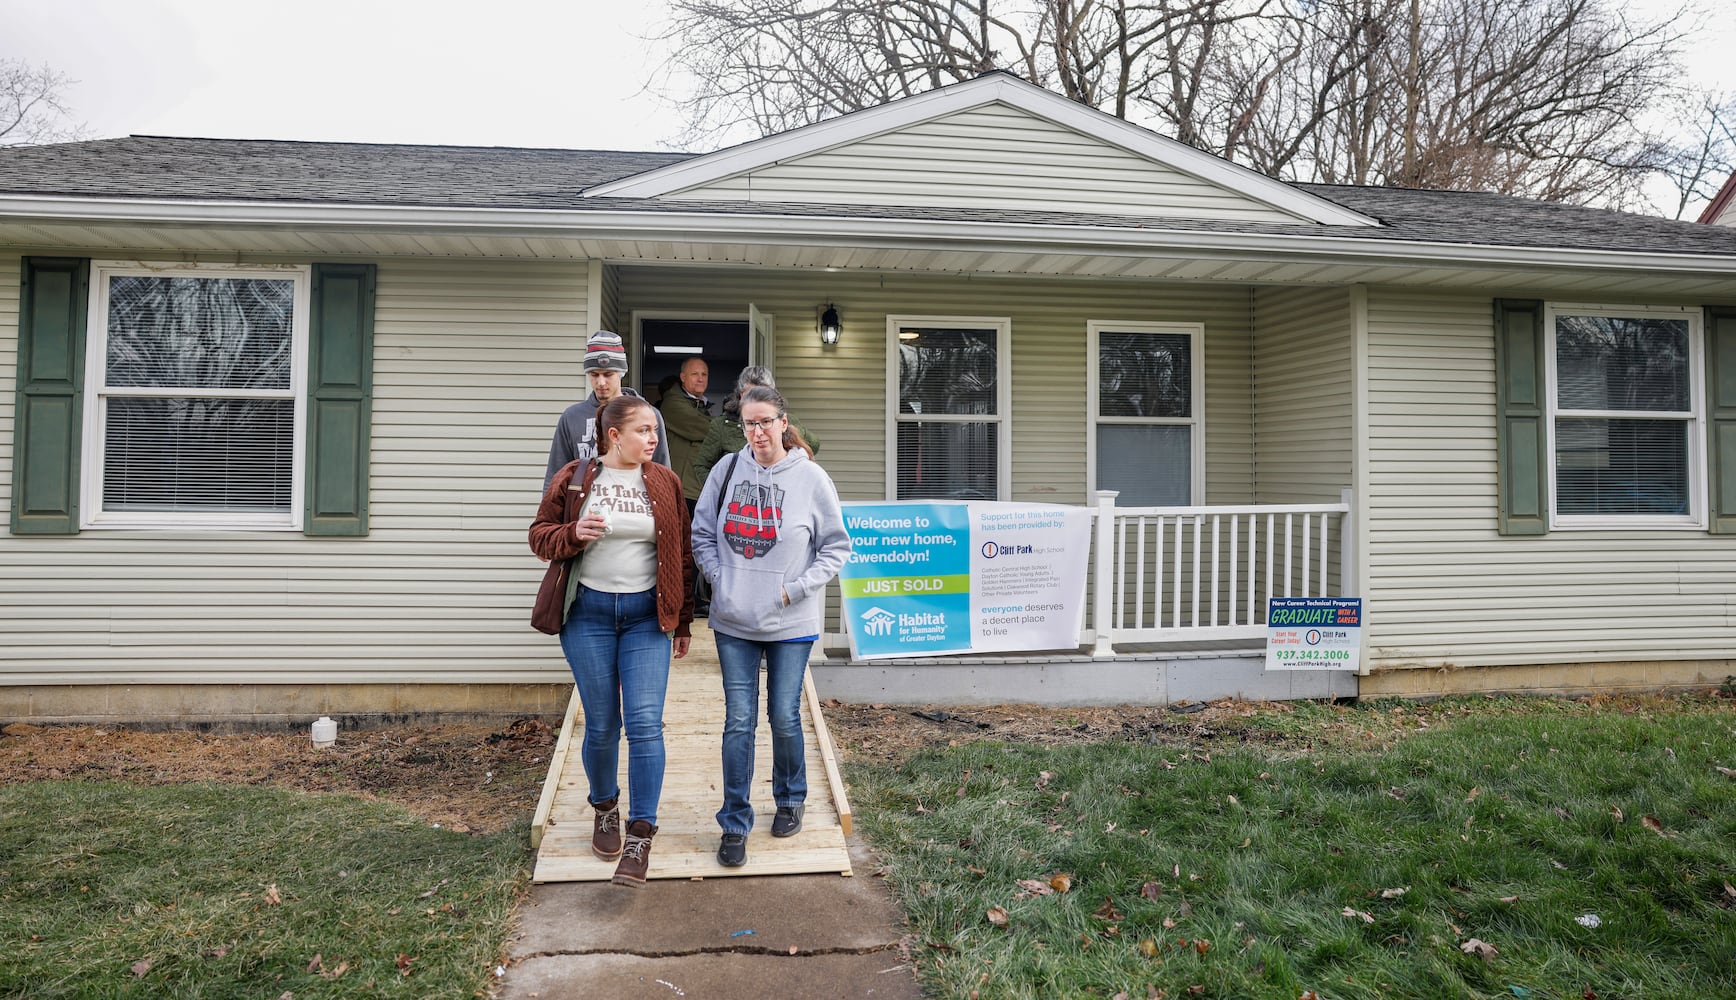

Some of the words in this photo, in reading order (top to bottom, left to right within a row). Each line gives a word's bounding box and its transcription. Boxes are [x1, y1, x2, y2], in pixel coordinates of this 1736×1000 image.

[612, 484, 650, 505] Take
[600, 498, 653, 517] Villag
[981, 513, 1012, 522] Support
[1015, 511, 1025, 519] for
[1027, 511, 1042, 519] this
[1043, 510, 1065, 518] home
[847, 517, 912, 529] Welcome
[914, 516, 930, 528] to
[981, 523, 996, 531] has
[1018, 520, 1052, 529] provided
[1053, 520, 1065, 528] by:
[881, 536, 911, 546] new
[914, 533, 957, 546] home,
[1000, 545, 1014, 555] Cliff
[1017, 544, 1033, 554] Park
[848, 550, 930, 564] Gwendolyn!
[863, 580, 899, 593] JUST
[903, 579, 944, 591] SOLD
[981, 605, 1023, 614] everyone
[1025, 603, 1064, 611] deserves
[898, 612, 945, 626] Habitat
[989, 616, 1019, 624] decent
[1021, 615, 1045, 624] place
[1271, 608, 1336, 624] GRADUATE
[1337, 616, 1359, 624] CAREER
[899, 627, 909, 635] for
[993, 627, 1008, 635] live
[926, 634, 946, 642] Dayton
[1276, 650, 1350, 660] 937.342.3006
